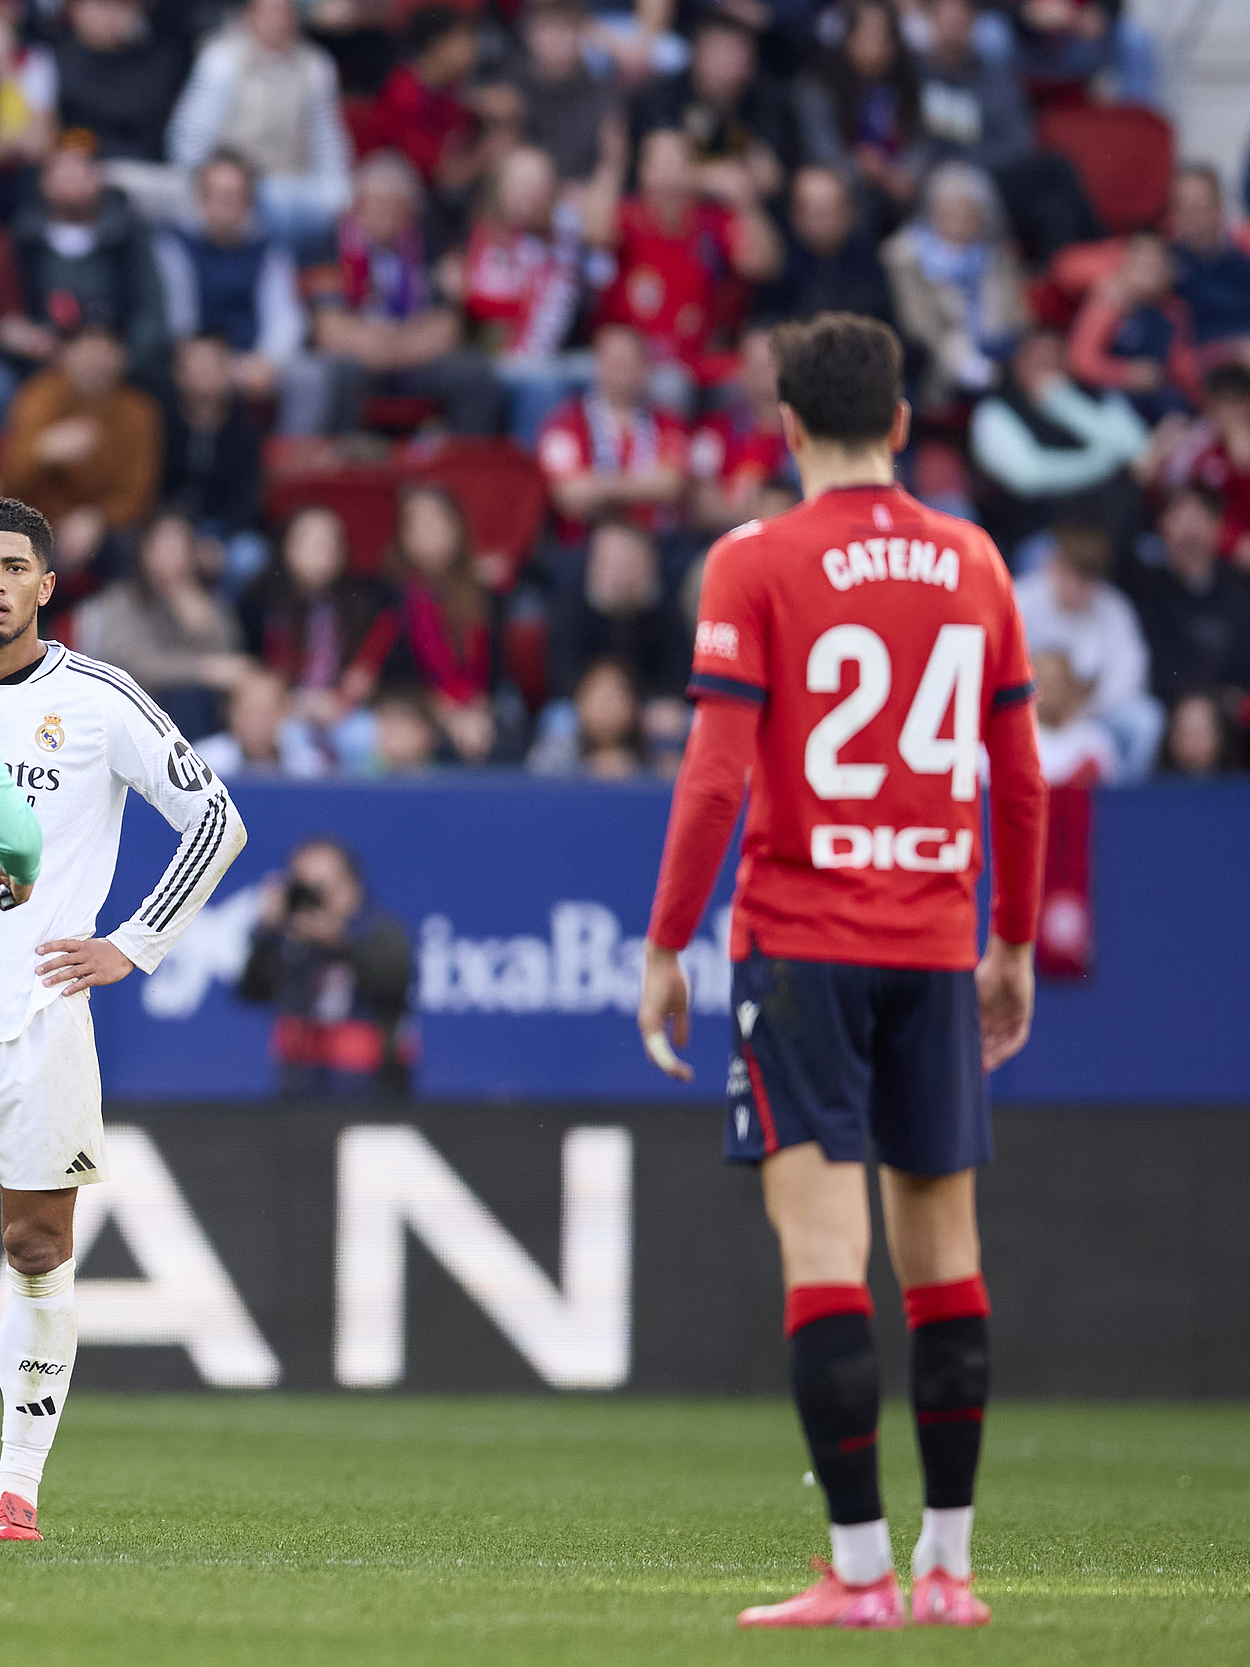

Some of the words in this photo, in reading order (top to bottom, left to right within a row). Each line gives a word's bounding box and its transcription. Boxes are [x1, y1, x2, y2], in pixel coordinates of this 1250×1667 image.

[822, 537, 960, 592] CATENA
[804, 622, 986, 802] 24
[167, 740, 213, 792] hp
[811, 824, 974, 873] DIGI
[18, 1359, 68, 1376] RMCF
